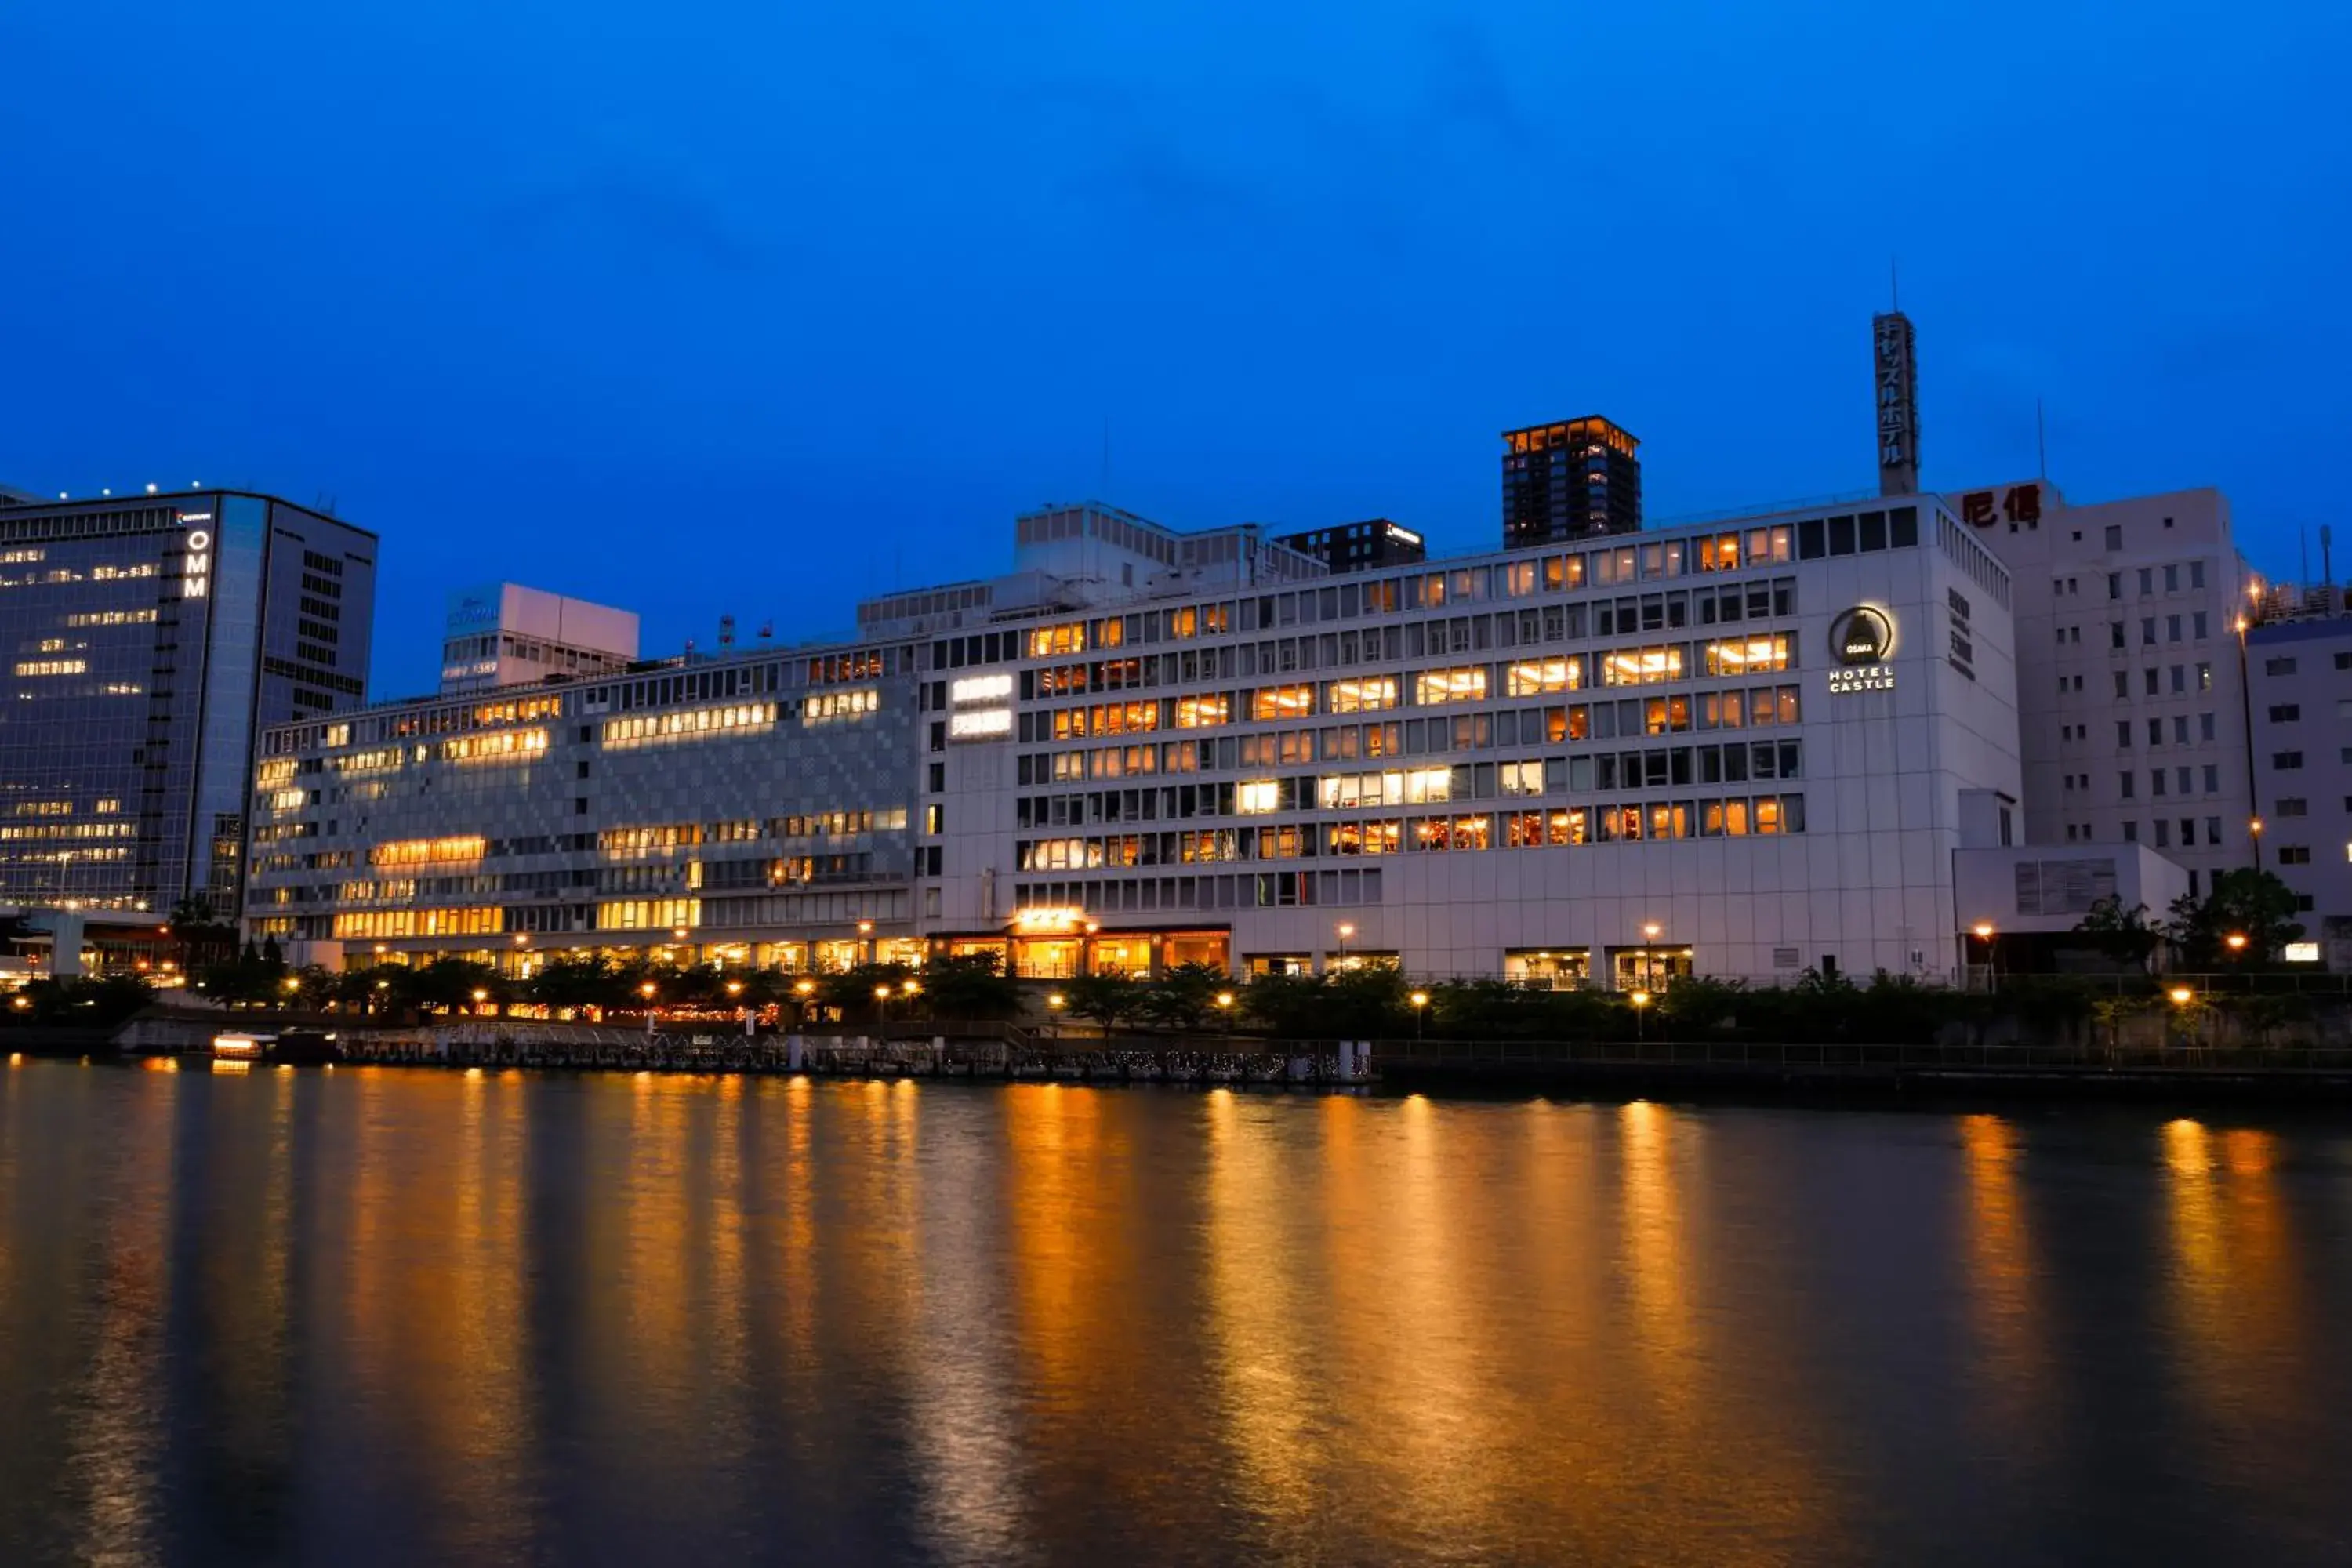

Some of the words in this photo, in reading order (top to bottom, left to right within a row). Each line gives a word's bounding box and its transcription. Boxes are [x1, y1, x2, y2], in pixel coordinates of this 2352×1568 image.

[184, 530, 209, 598] OMM
[1828, 666, 1893, 681] HOTEL
[1829, 678, 1895, 693] CASTLE
